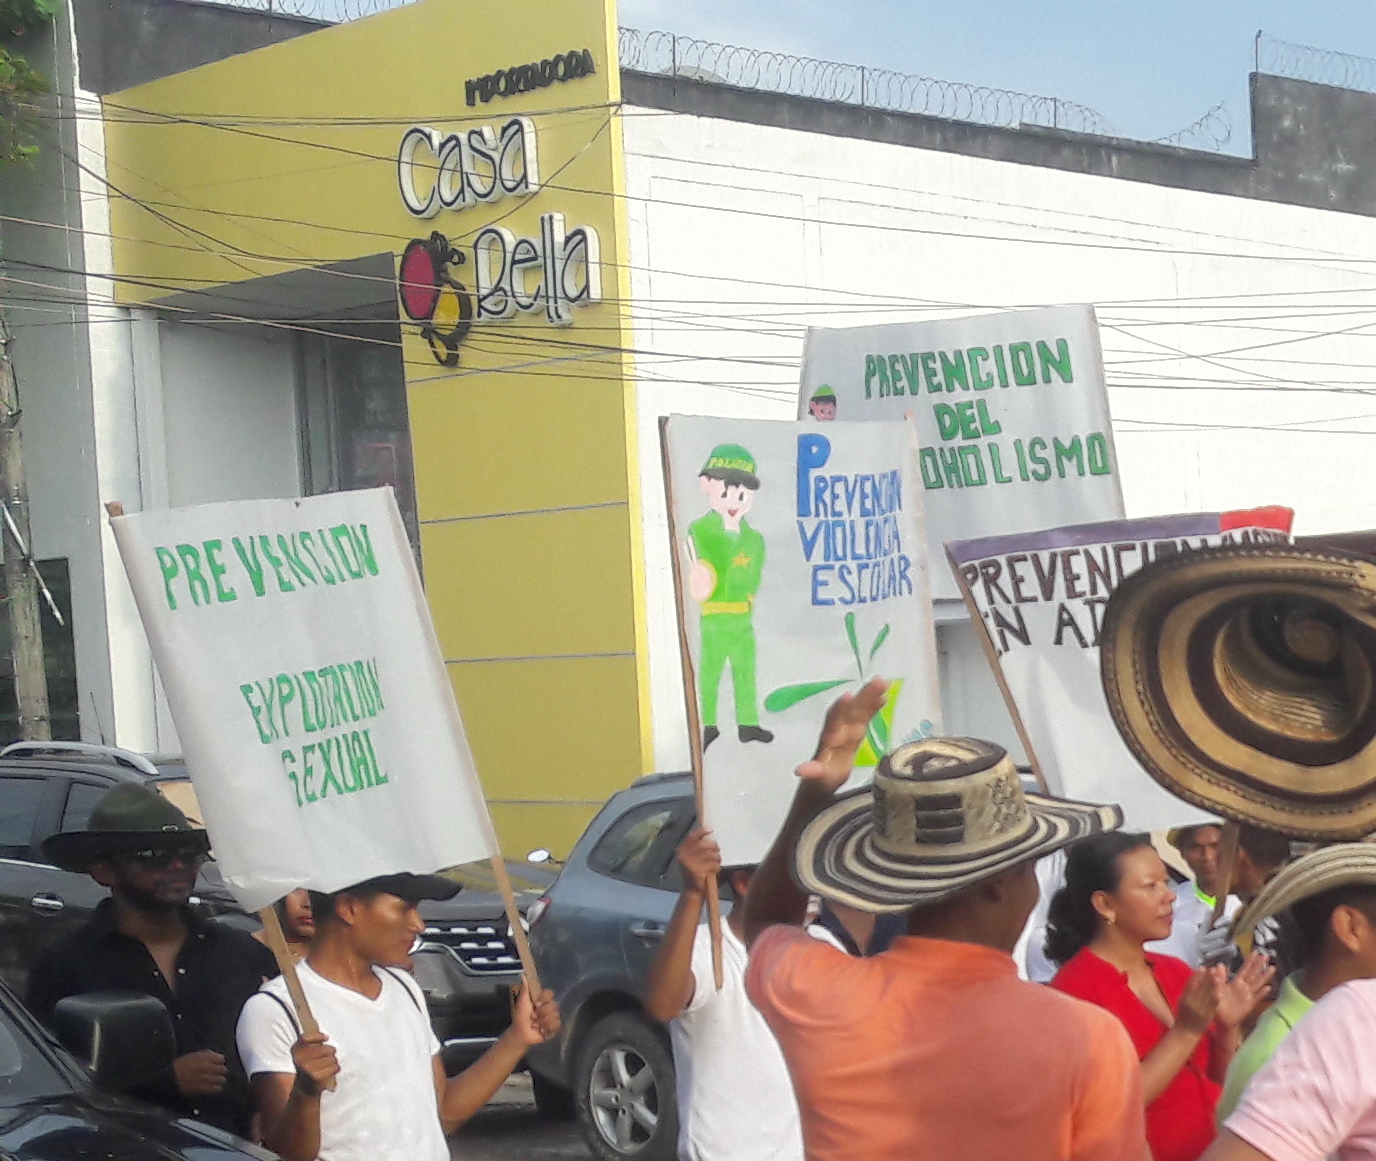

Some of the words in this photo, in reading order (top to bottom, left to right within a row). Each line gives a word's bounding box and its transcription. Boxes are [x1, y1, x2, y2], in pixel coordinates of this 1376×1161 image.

[398, 116, 540, 219] Casa
[474, 212, 603, 327] Bella
[864, 338, 1074, 400] PREVENCION
[933, 399, 1002, 440] DEL
[916, 432, 1112, 490] OHOLISMO
[281, 728, 389, 807] SEXUAL
